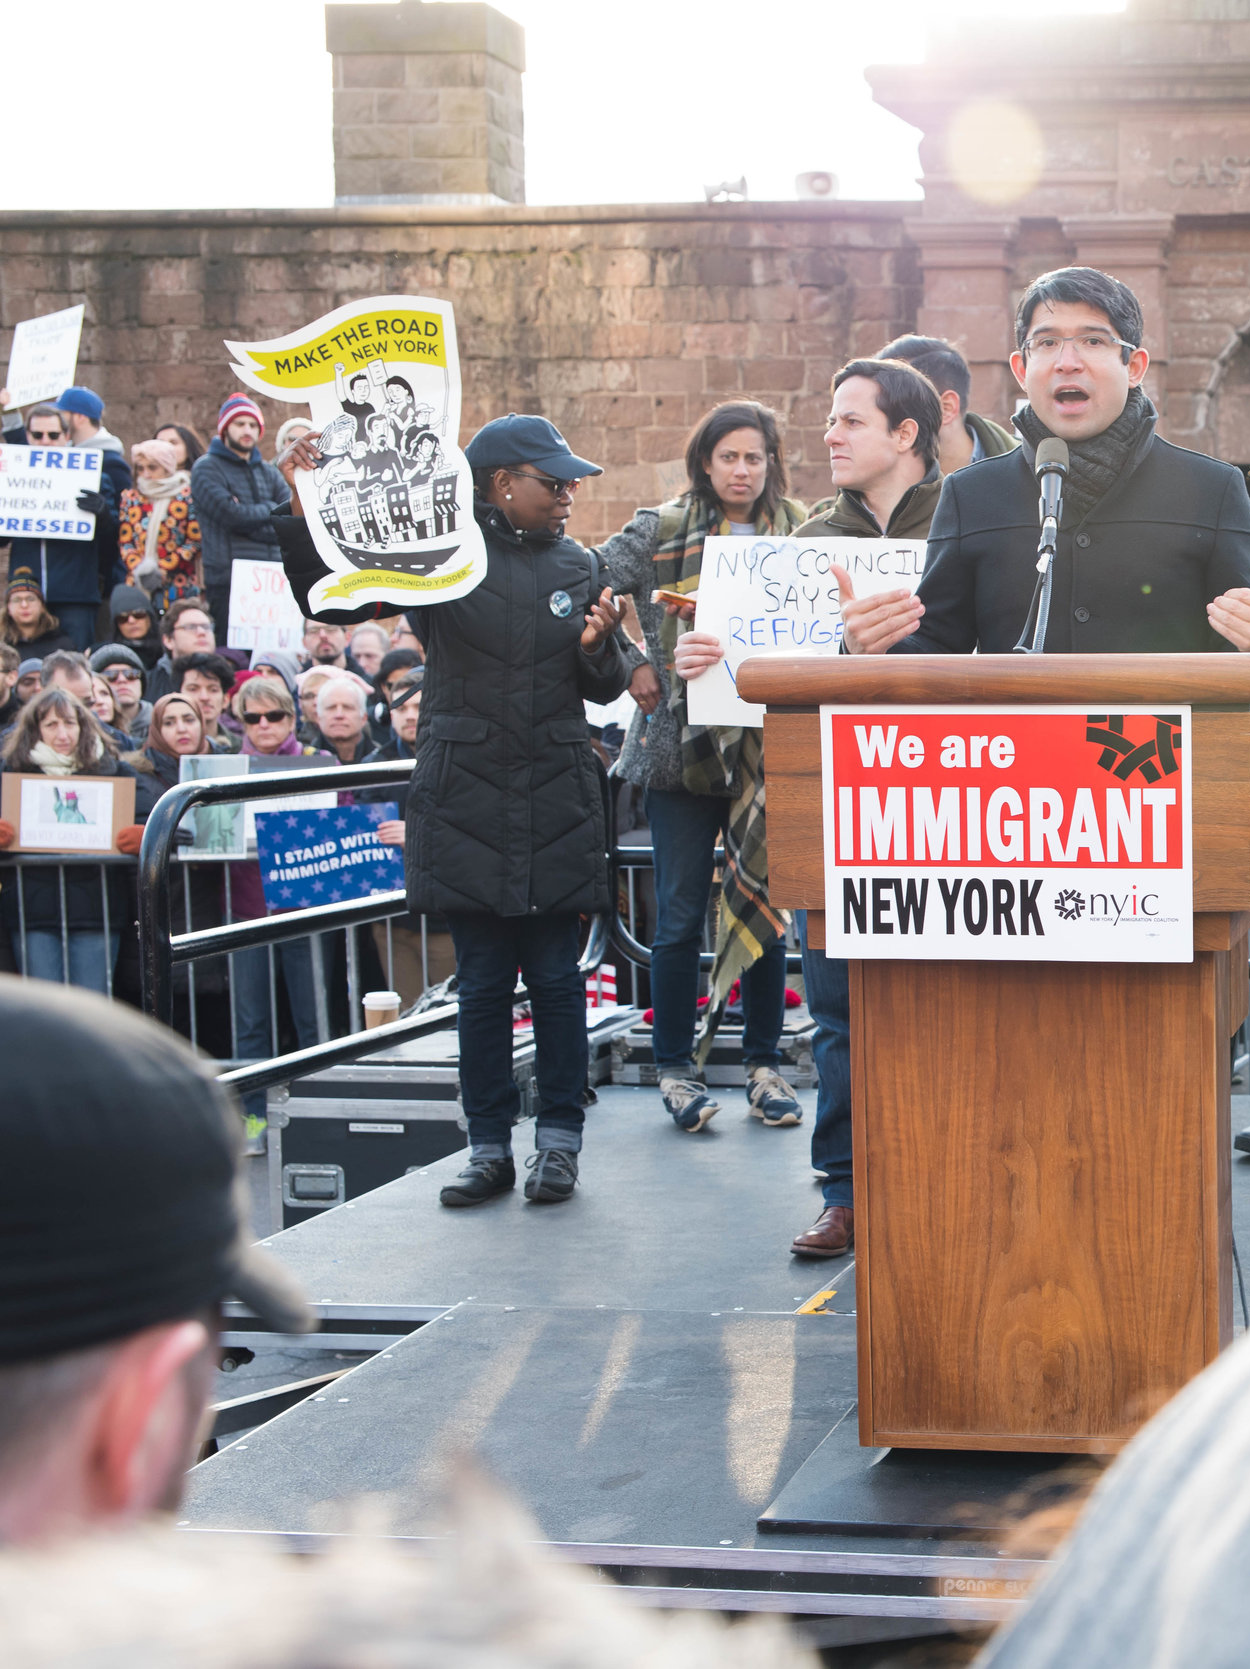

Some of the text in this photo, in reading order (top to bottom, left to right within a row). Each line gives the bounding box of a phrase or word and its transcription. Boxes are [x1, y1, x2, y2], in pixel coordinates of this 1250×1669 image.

[274, 318, 439, 375] MAKE THE ROAD
[351, 340, 439, 363] NEW YORK
[29, 450, 99, 470] FREE
[7, 477, 52, 490] WHEN
[0, 497, 69, 512] HERS ARE
[343, 575, 383, 590] DIGNIDAD,
[385, 576, 432, 588] COMUNIDAD
[441, 570, 467, 585] PODER
[716, 549, 923, 584] NYC COUNCIL
[765, 582, 841, 614] SAYS
[729, 617, 844, 647] REFUGE
[854, 725, 1016, 768] We are
[838, 786, 1177, 863] IMMIGRANT
[269, 848, 394, 882] #IMMIGRANTNY
[275, 852, 281, 865] I
[285, 841, 337, 864] STAND
[843, 877, 1045, 936] NEW YORK
[1090, 885, 1159, 926] nyic
